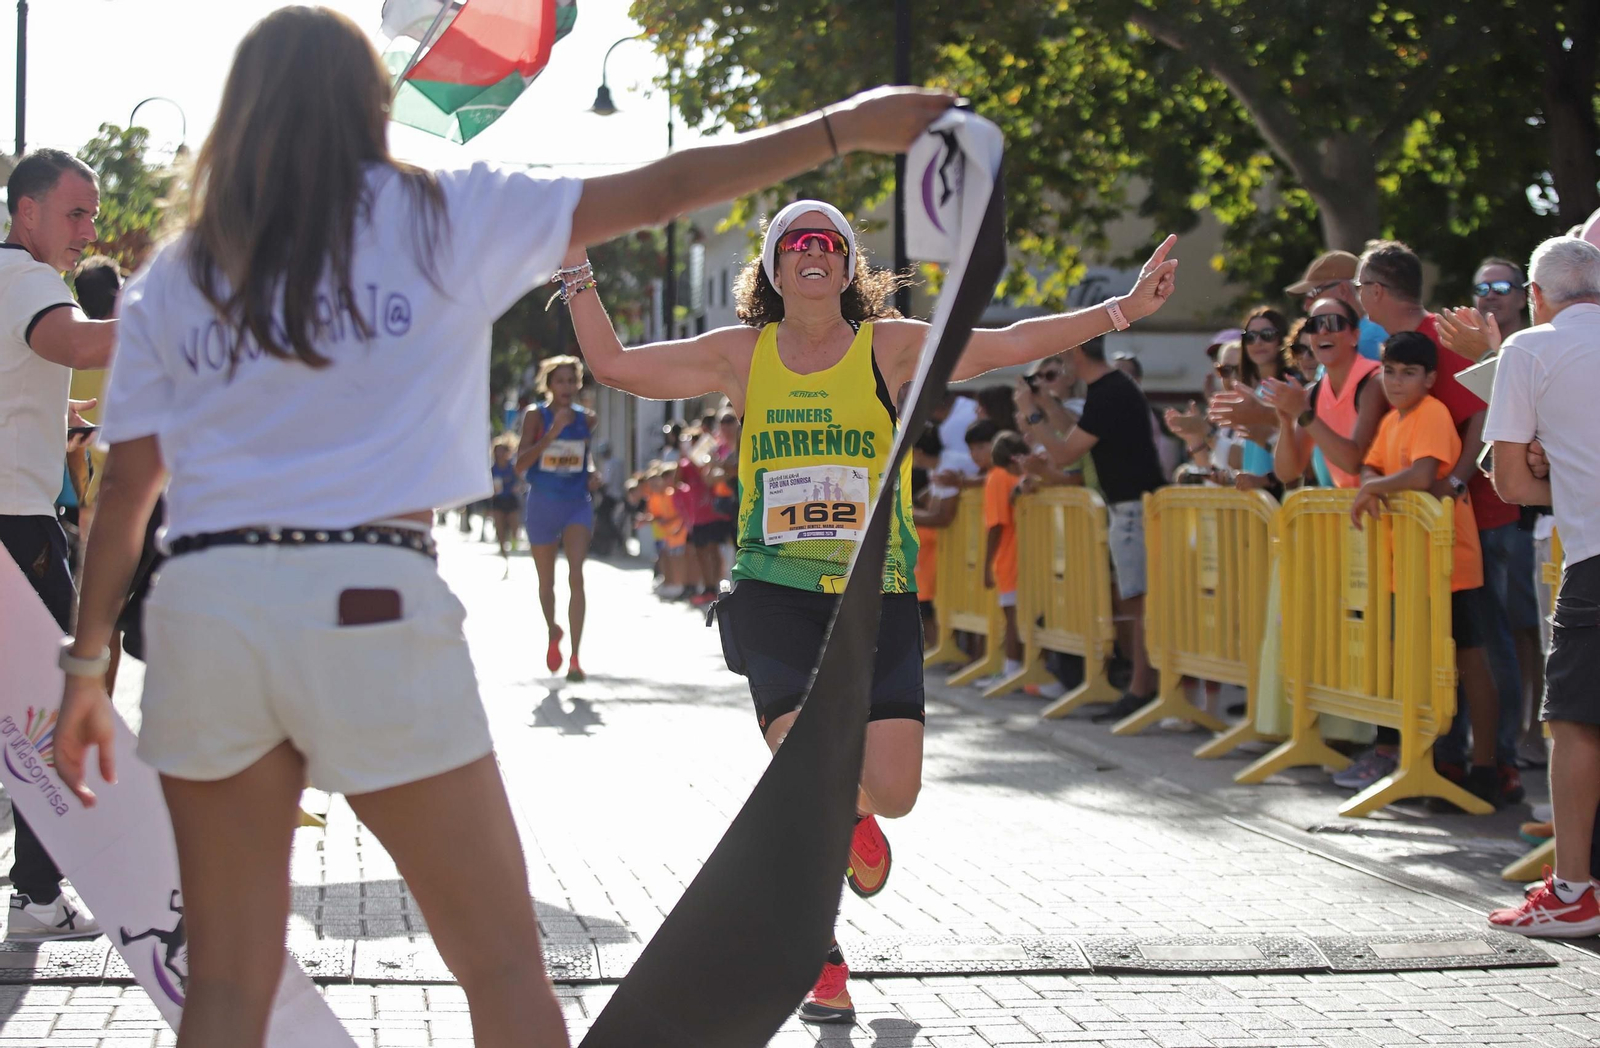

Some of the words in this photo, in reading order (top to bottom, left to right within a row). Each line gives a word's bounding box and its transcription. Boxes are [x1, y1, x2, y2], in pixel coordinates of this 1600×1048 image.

[766, 408, 833, 424] RUNNERS
[751, 423, 876, 463] BARREÑOS
[769, 481, 779, 489] POR
[779, 479, 789, 487] UNA
[790, 476, 811, 486] SONRISA
[780, 502, 857, 525] 162
[23, 756, 69, 817] sonrisa
